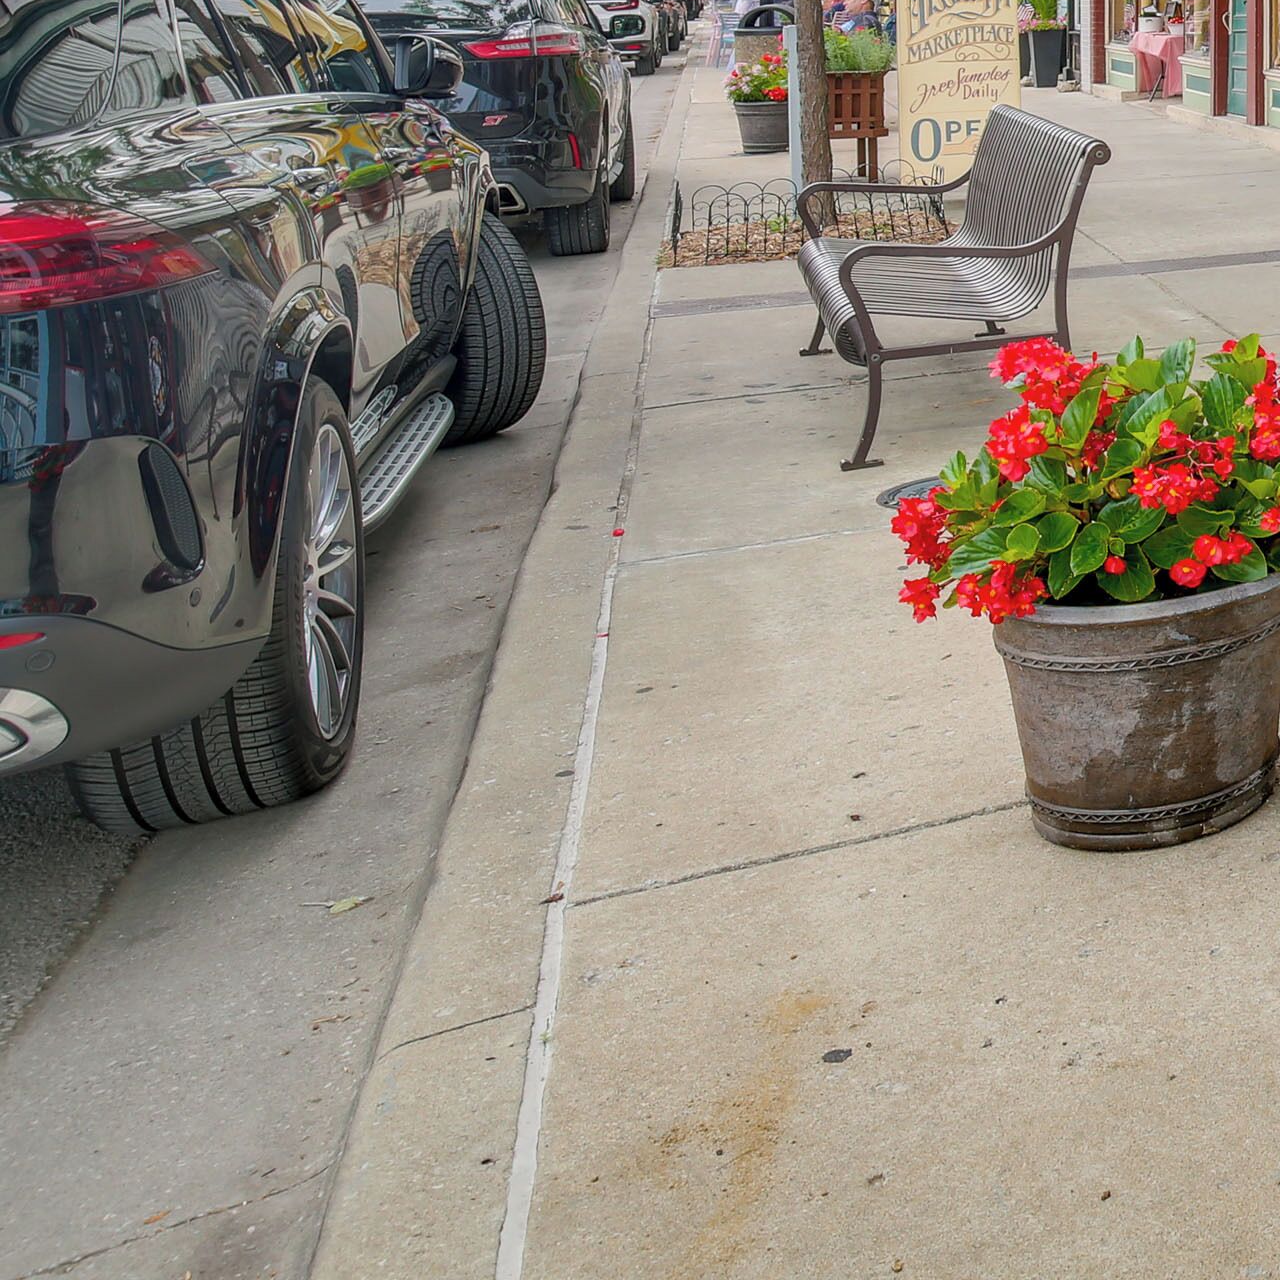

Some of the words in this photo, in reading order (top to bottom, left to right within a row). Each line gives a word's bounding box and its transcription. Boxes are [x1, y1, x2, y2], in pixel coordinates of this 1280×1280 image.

[906, 25, 1015, 65] MARKETPLACE
[910, 79, 954, 114] Free
[950, 65, 1013, 97] Samples
[963, 83, 999, 103] Daily
[482, 114, 508, 127] ST
[911, 117, 982, 163] OPE
